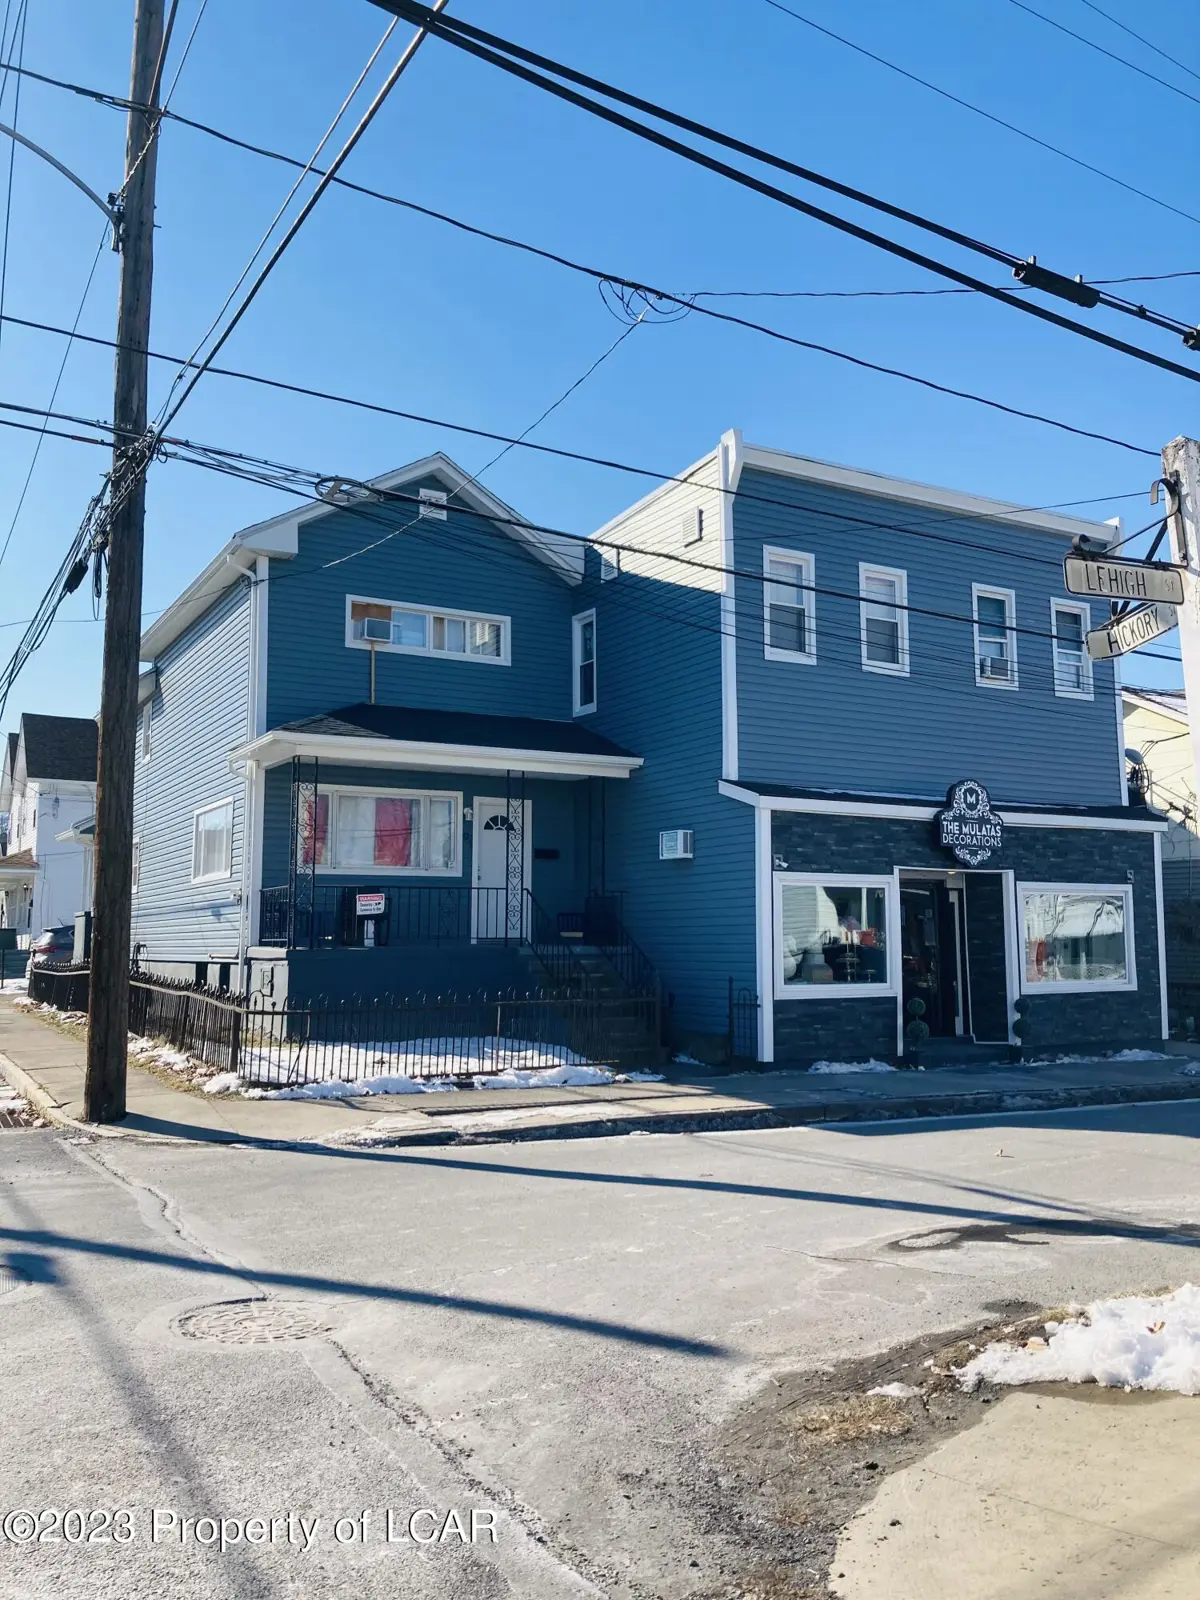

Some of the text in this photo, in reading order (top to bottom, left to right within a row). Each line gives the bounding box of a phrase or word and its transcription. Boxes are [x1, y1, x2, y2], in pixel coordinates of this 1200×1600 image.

[1085, 563, 1147, 596] LEHIGH
[1106, 606, 1160, 653] HICKORY
[966, 792, 976, 804] M
[942, 821, 1002, 837] THE MULATAS
[942, 833, 1002, 847] DECORATIONS
